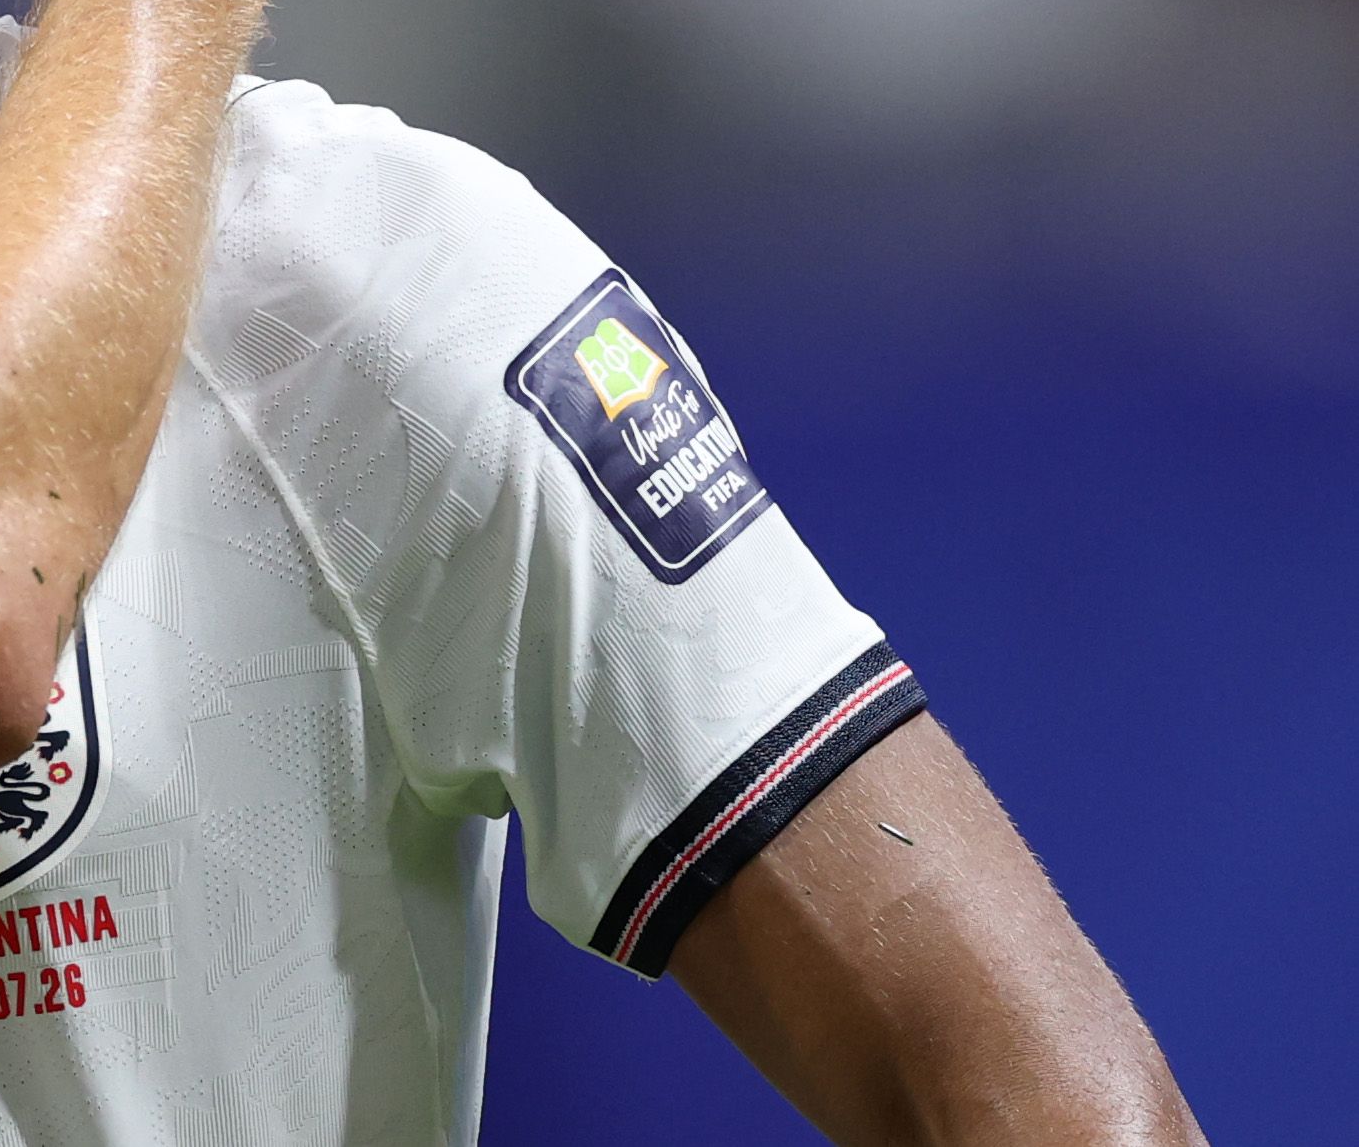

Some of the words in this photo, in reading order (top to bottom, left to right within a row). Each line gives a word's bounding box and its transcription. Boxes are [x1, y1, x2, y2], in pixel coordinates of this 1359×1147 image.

[621, 403, 682, 465] Unite
[668, 380, 701, 424] For
[702, 470, 745, 512] FIFA
